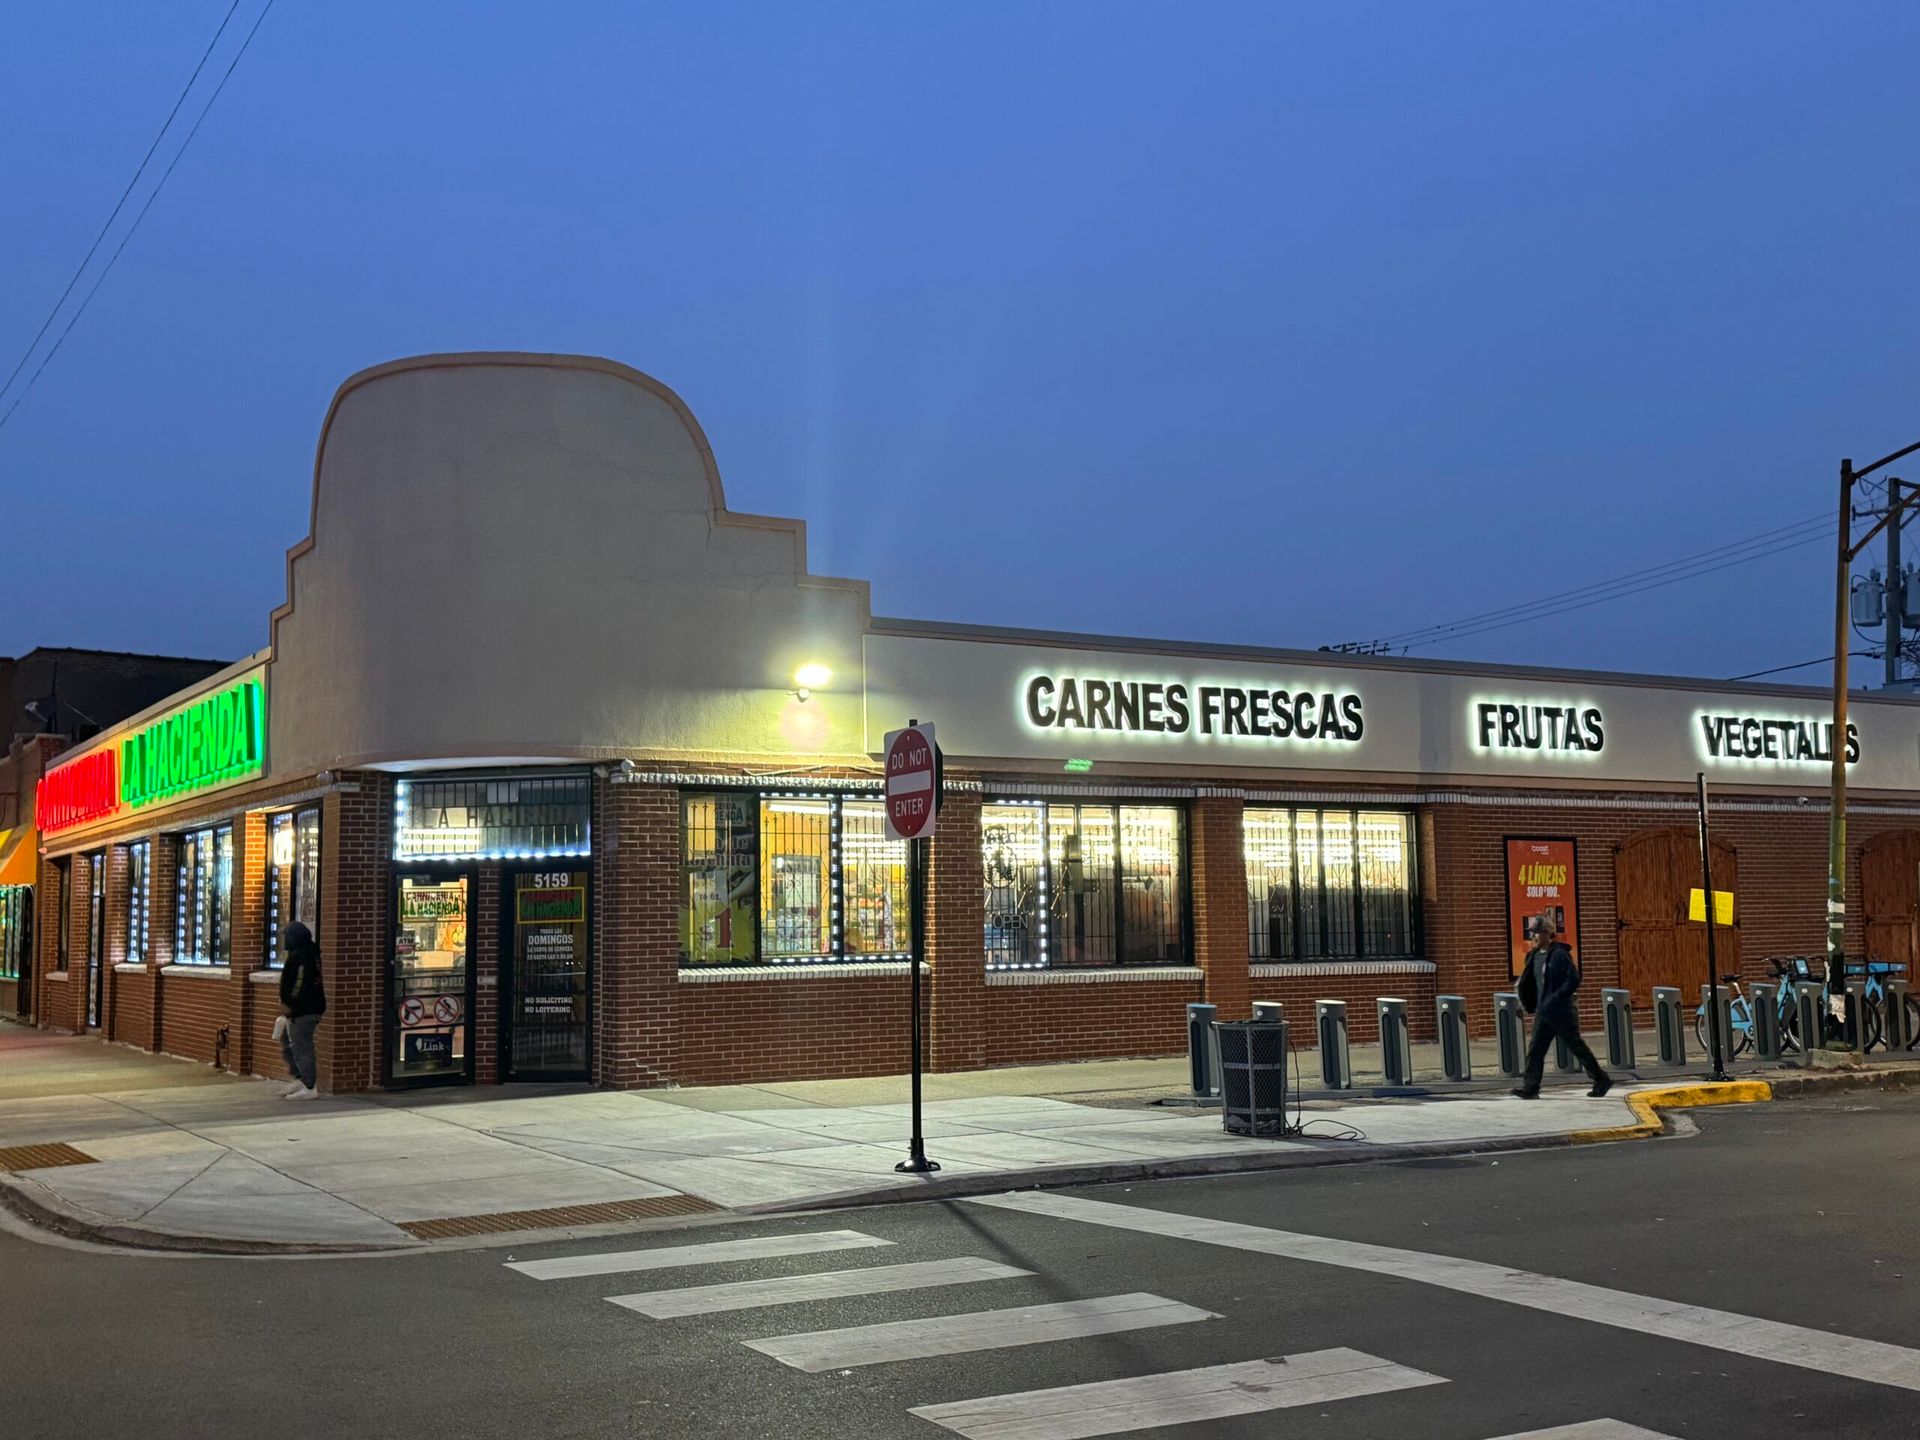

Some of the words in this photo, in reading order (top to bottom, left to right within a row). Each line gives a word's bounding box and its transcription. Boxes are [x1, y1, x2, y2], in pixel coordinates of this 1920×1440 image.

[1026, 675, 1190, 733] CARNES
[1198, 686, 1364, 741] FRESCAS
[1477, 703, 1604, 752] FRUTAS
[121, 733, 146, 803] LA
[147, 683, 256, 795] HACIENDA
[1700, 715, 1860, 764] VEGETALS
[892, 753, 904, 770] DO
[909, 747, 928, 767] NOT
[895, 798, 924, 818] ENTER
[534, 872, 569, 889] 5159
[1518, 864, 1527, 886] 4
[1527, 861, 1567, 886] LÍNEAS
[993, 914, 1028, 929] OPEN
[528, 934, 574, 945] DOMINGOS
[424, 1042, 444, 1052] Link
